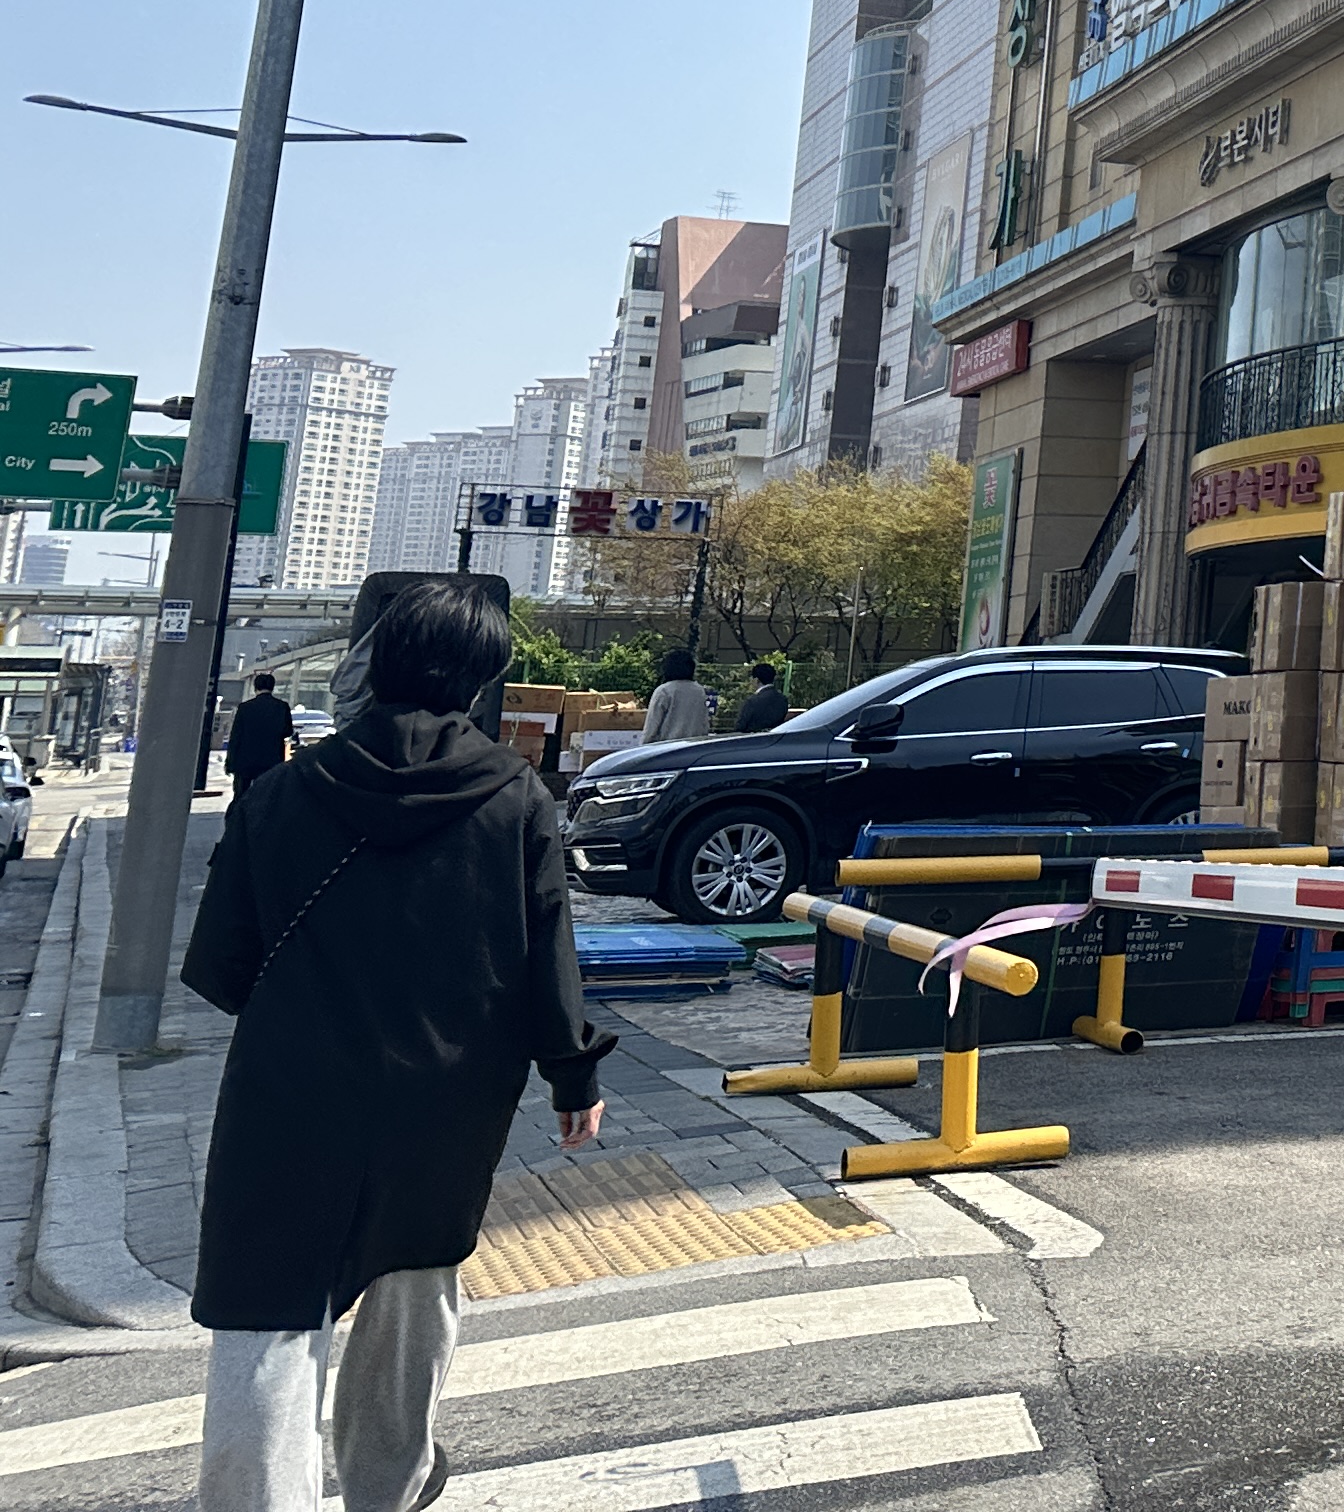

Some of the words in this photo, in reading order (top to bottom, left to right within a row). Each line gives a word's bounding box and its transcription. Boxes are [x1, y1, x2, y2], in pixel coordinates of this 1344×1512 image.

[48, 421, 92, 437] 250m
[5, 455, 35, 471] City
[164, 619, 183, 629] 4-2
